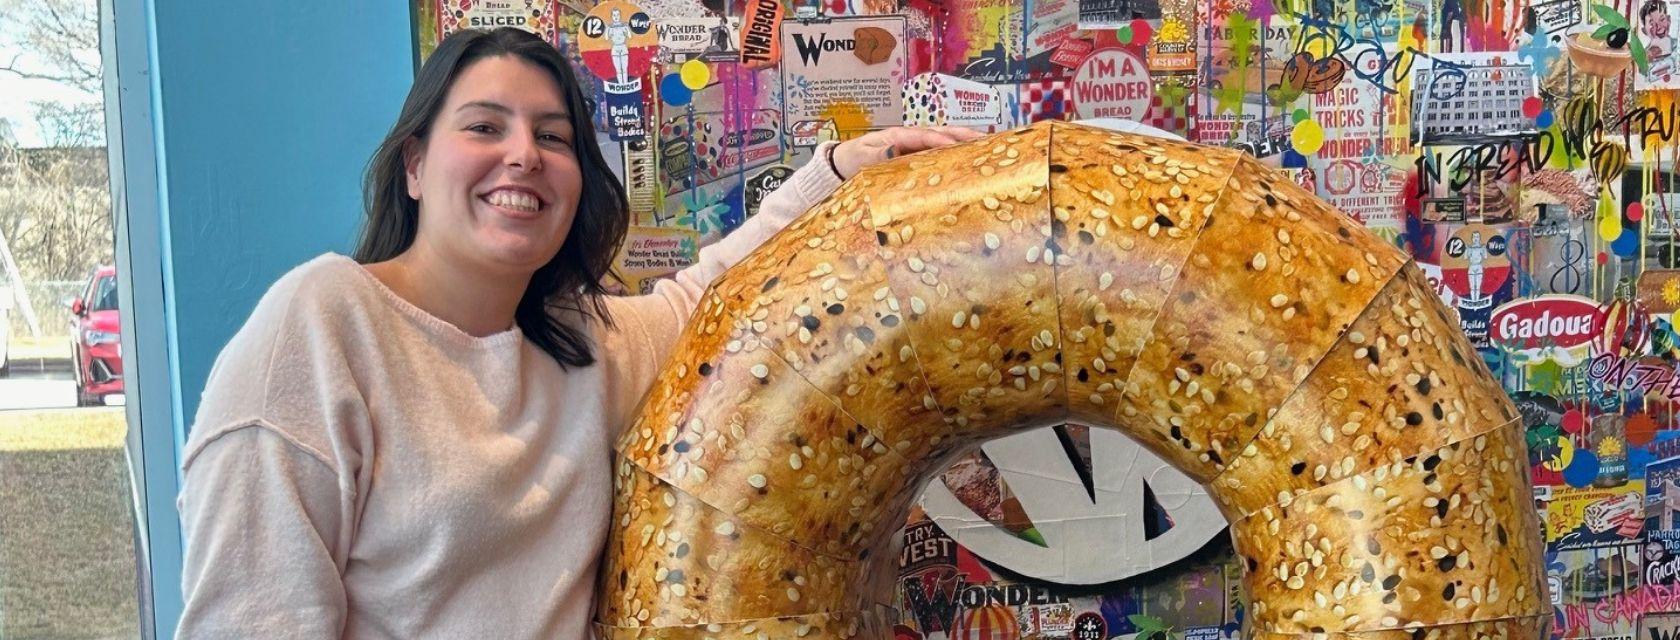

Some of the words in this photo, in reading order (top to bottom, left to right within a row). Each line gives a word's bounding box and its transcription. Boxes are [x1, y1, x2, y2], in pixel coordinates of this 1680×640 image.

[471, 16, 526, 26] SLICED
[586, 20, 603, 35] 12
[655, 24, 707, 42] WONDER
[671, 34, 702, 42] BREAD
[743, 0, 778, 64] ORIGINAL
[1204, 27, 1258, 41] LABR
[1265, 27, 1297, 41] DAY
[792, 32, 857, 67] WOND
[1088, 57, 1116, 79] I'M
[1121, 57, 1137, 77] A
[607, 80, 640, 92] WONDER
[1075, 80, 1149, 104] WONDER
[954, 89, 991, 103] WONDER
[1315, 87, 1360, 108] MAGIC
[610, 105, 638, 118] Builds
[1093, 105, 1132, 118] BREAD
[1315, 109, 1366, 129] TRICKS
[1317, 137, 1373, 160] WONDER
[1416, 154, 1442, 200] IN
[1446, 130, 1556, 192] BREAD
[1607, 101, 1680, 160] TRU
[1449, 239, 1465, 256] 12
[1499, 310, 1594, 340] Gadoua
[1589, 353, 1638, 390] ON
[1631, 364, 1680, 400] THE
[905, 525, 934, 544] TRY
[900, 537, 953, 568] VEST
[1566, 601, 1590, 631] IN
[1078, 629, 1100, 639] 1911
